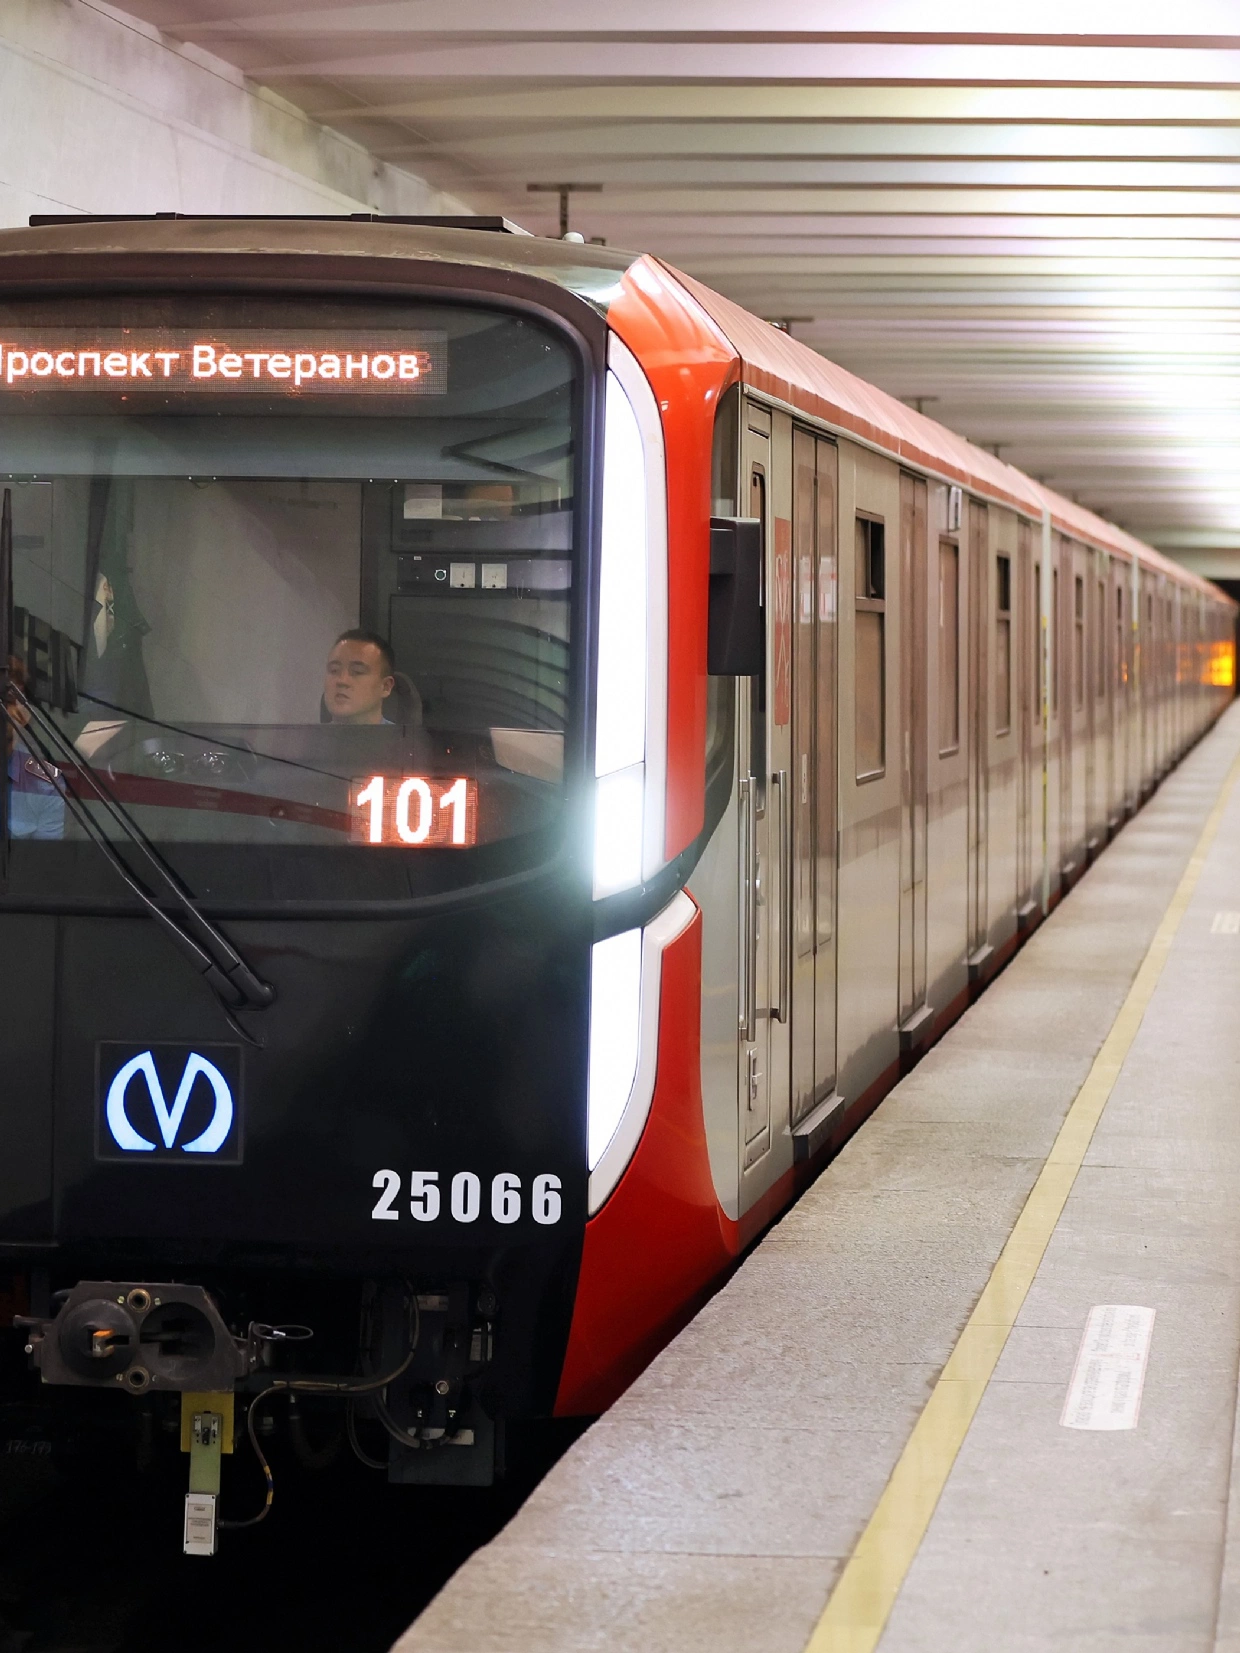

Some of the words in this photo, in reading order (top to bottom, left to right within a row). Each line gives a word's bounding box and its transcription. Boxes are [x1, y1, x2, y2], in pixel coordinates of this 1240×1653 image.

[192, 344, 420, 386] Ветеранов
[357, 776, 467, 844] 101
[371, 1168, 562, 1225] 25066
